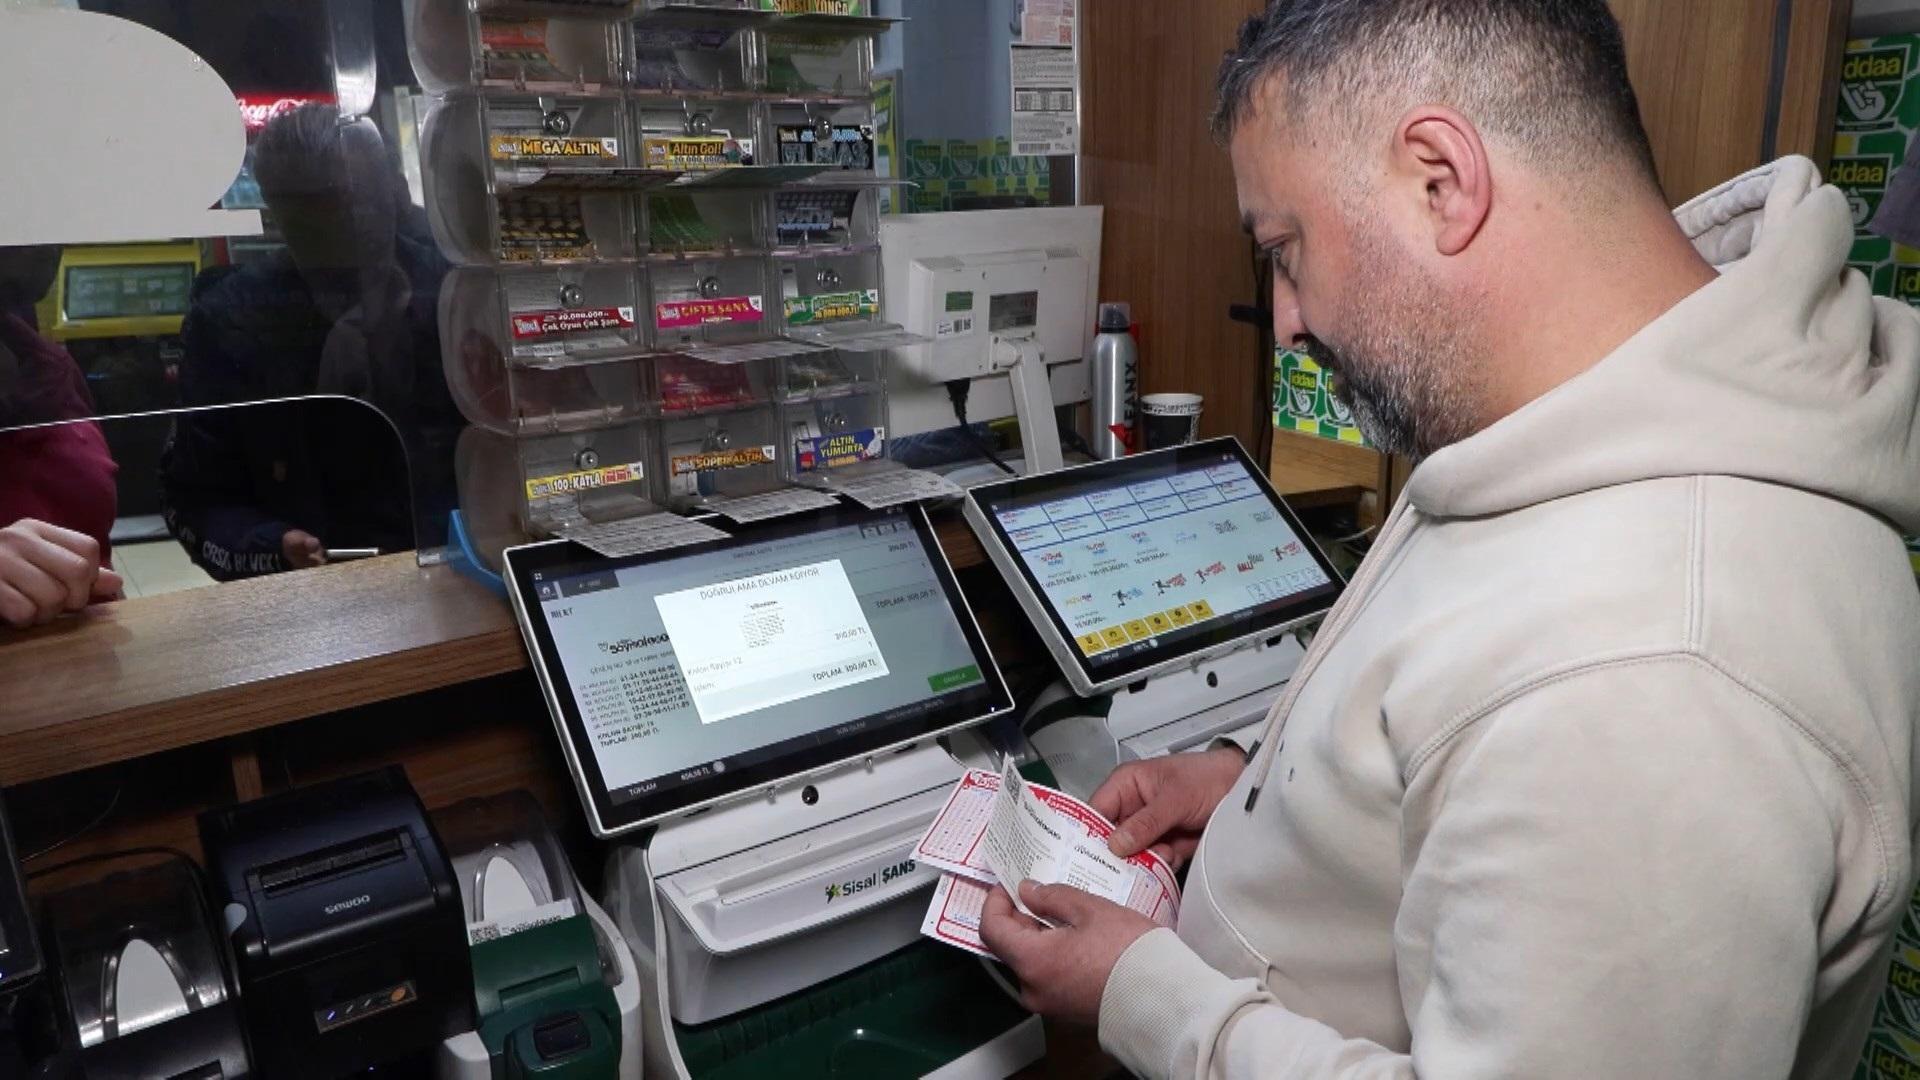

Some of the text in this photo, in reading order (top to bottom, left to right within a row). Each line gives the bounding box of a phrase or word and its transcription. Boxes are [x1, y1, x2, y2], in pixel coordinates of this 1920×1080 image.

[1844, 55, 1901, 78] ddaa
[522, 139, 561, 155] MEGA
[563, 139, 600, 155] ALTIN
[1830, 163, 1884, 185] ddaa
[829, 436, 855, 448] ALTIN
[820, 444, 864, 458] YUMURTA
[573, 472, 601, 489] KATLA
[758, 574, 789, 589] DEVAM
[842, 859, 916, 896] Sisal ŞANS
